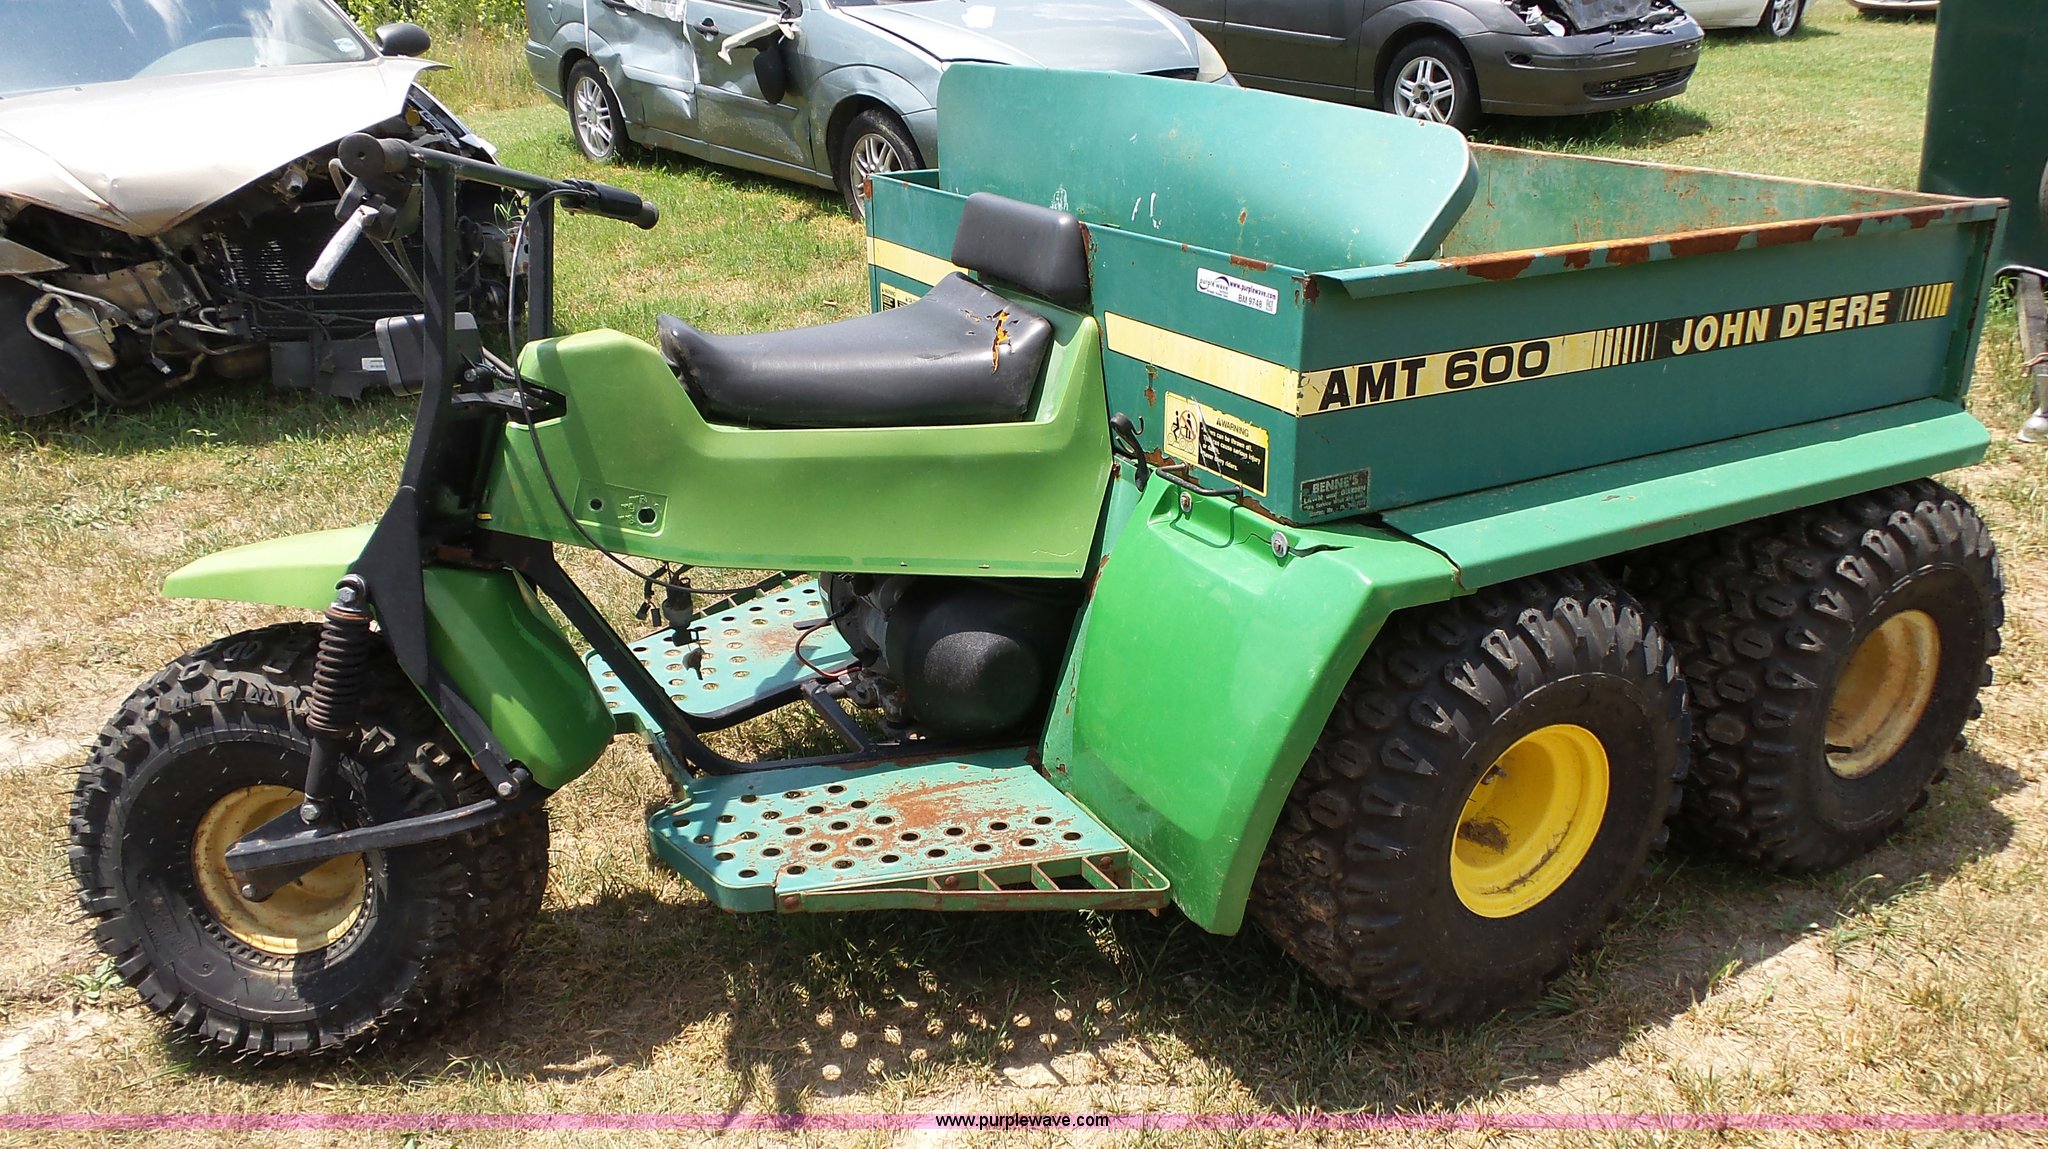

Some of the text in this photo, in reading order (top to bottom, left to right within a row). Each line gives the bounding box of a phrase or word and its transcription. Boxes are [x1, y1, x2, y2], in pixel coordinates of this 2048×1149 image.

[1230, 281, 1276, 300] www.purplewave.com
[1238, 294, 1262, 308] BM 9748
[1672, 291, 1892, 355] JOHN DEERE
[1318, 341, 1550, 411] AMT 600
[1221, 419, 1249, 438] WARNING
[1312, 474, 1359, 494] BENNE'S
